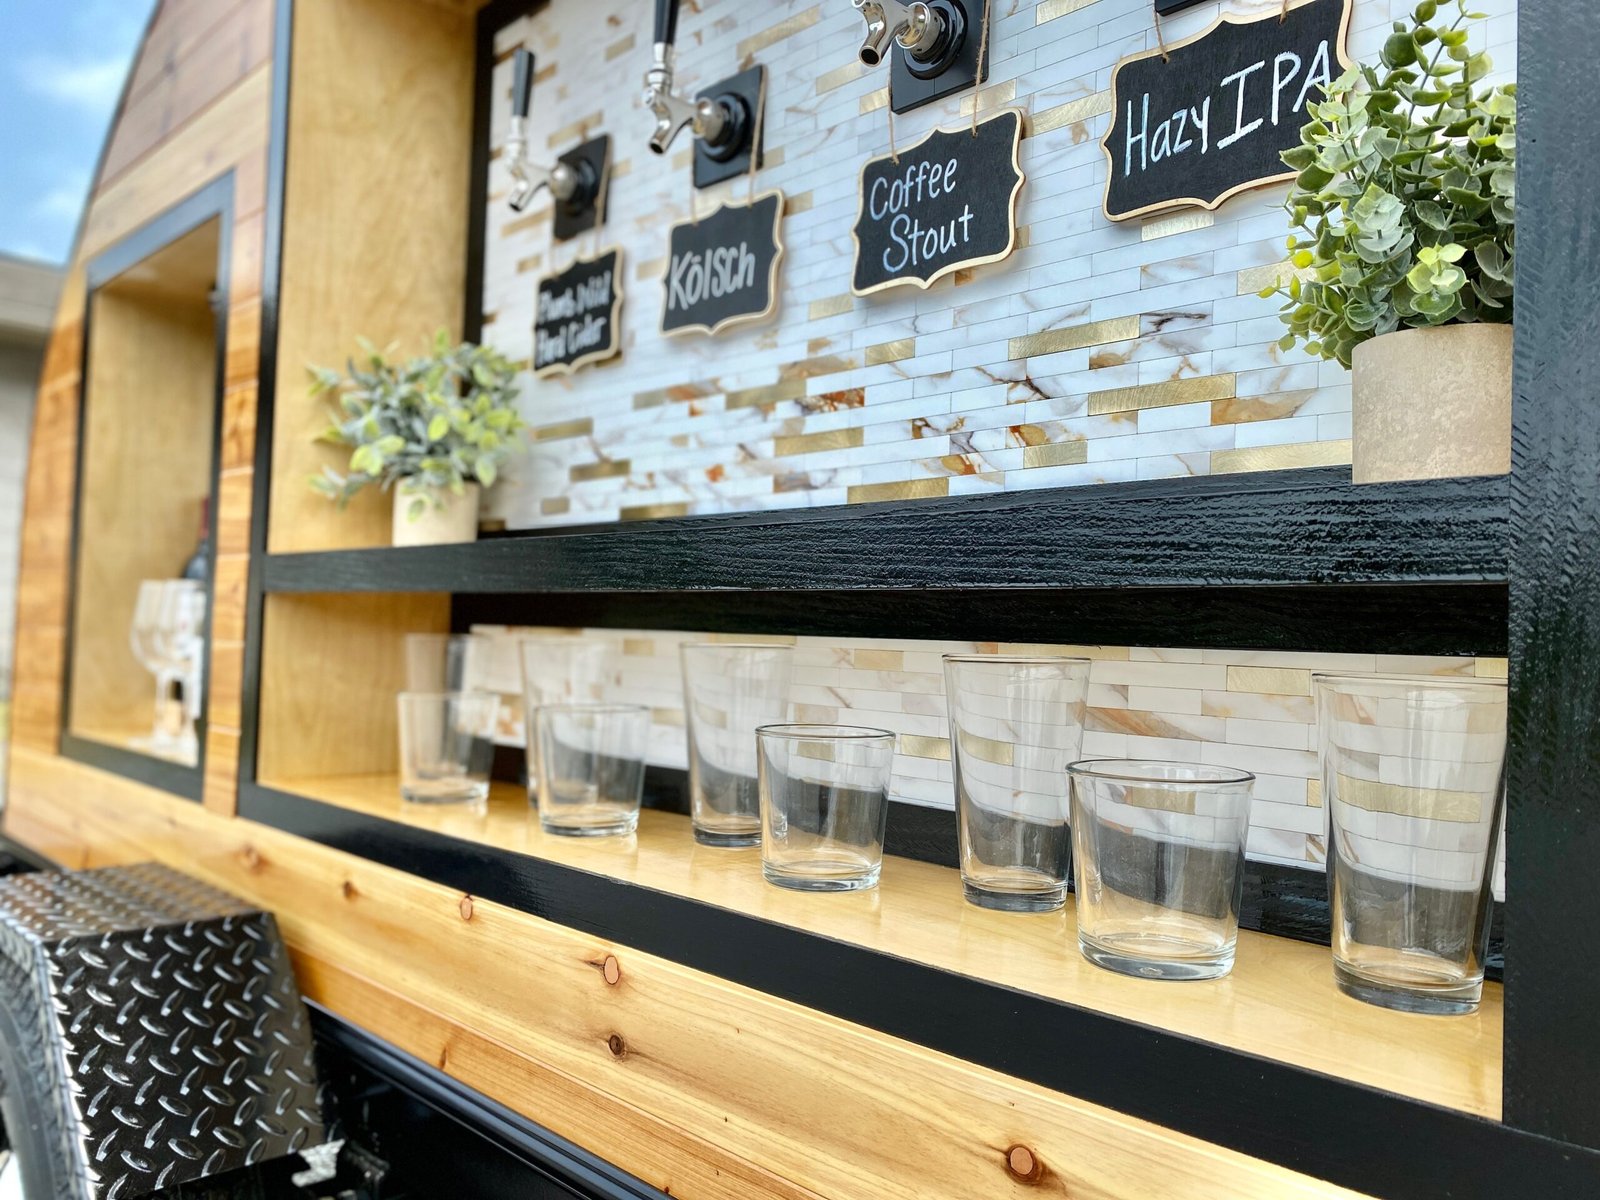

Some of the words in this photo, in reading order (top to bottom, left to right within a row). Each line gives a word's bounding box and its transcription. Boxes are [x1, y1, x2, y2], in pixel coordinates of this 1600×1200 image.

[1124, 93, 1210, 177] Hazy
[1217, 40, 1331, 149] IPA
[869, 158, 957, 221] Coffee
[882, 213, 974, 273] Stout
